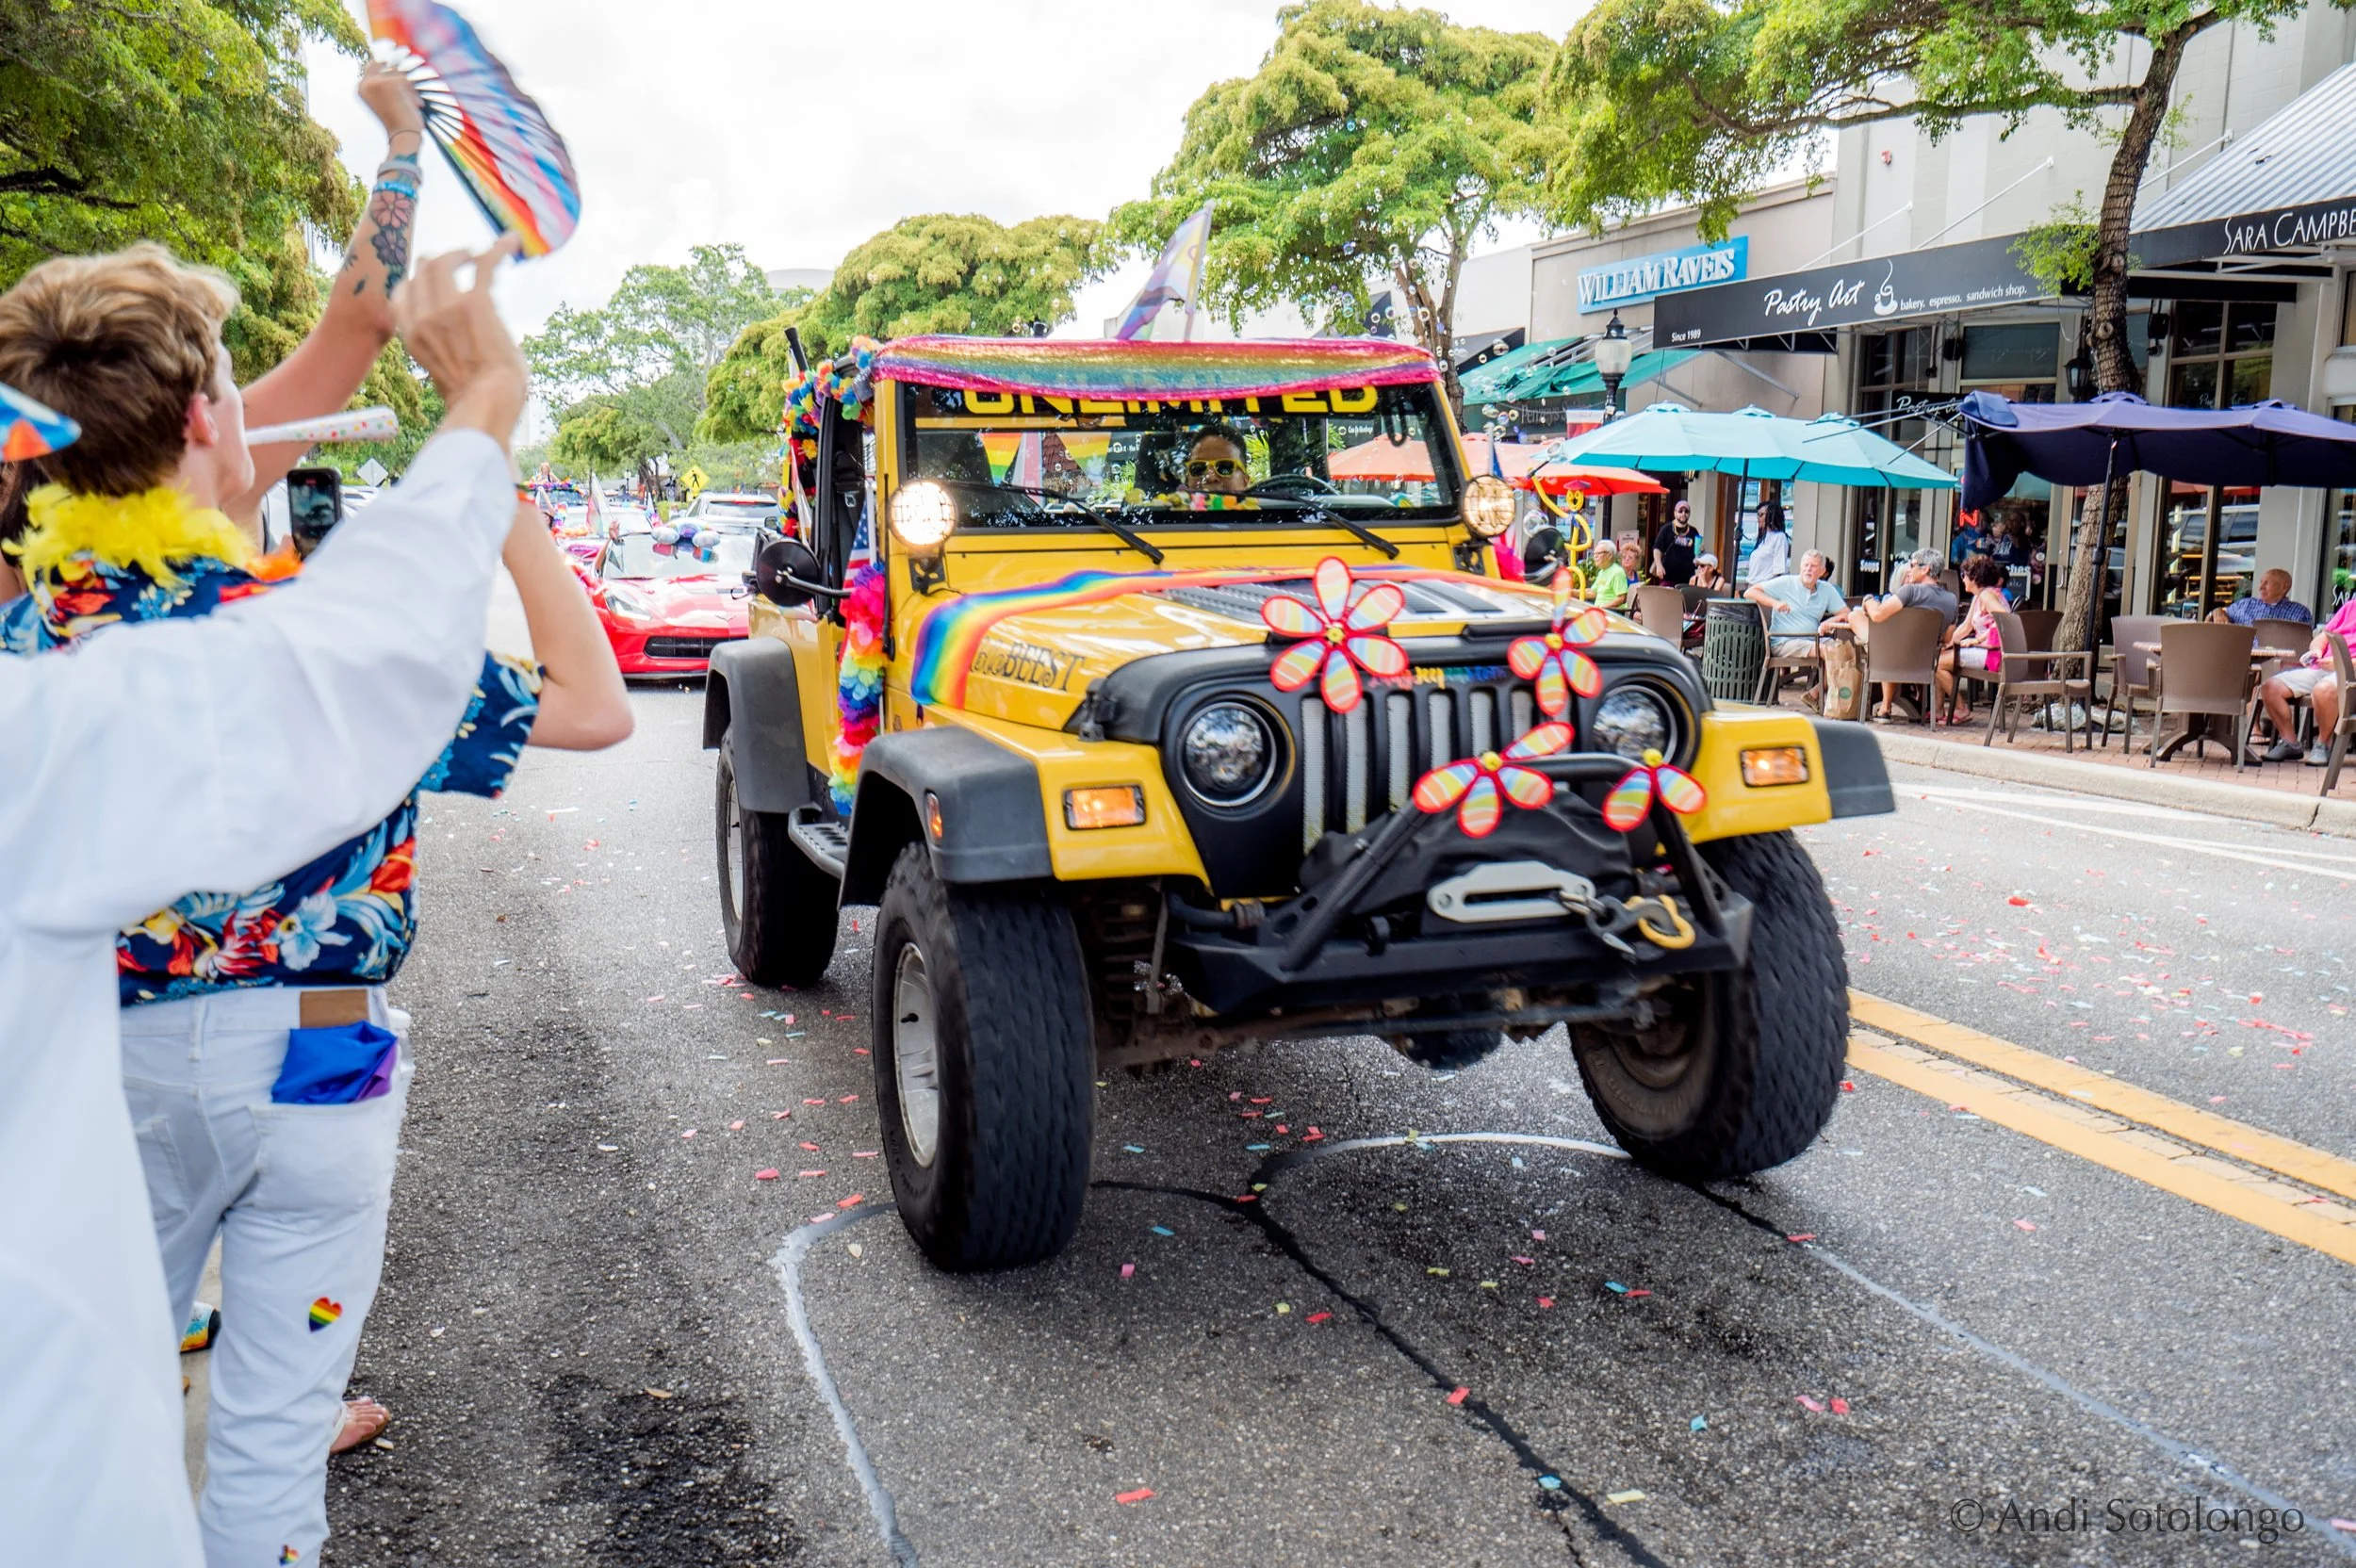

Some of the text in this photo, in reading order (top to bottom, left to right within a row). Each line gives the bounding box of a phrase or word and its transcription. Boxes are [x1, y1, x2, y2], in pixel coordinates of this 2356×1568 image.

[2223, 217, 2267, 255] SARA
[1578, 248, 1736, 305] WILLIAM RAVEIS
[1763, 278, 1865, 327] Pastry Art
[1900, 299, 1925, 311] bakery.
[1929, 293, 1962, 309] espresso.
[1966, 286, 2004, 302] sandwich
[1671, 332, 1687, 343] Since
